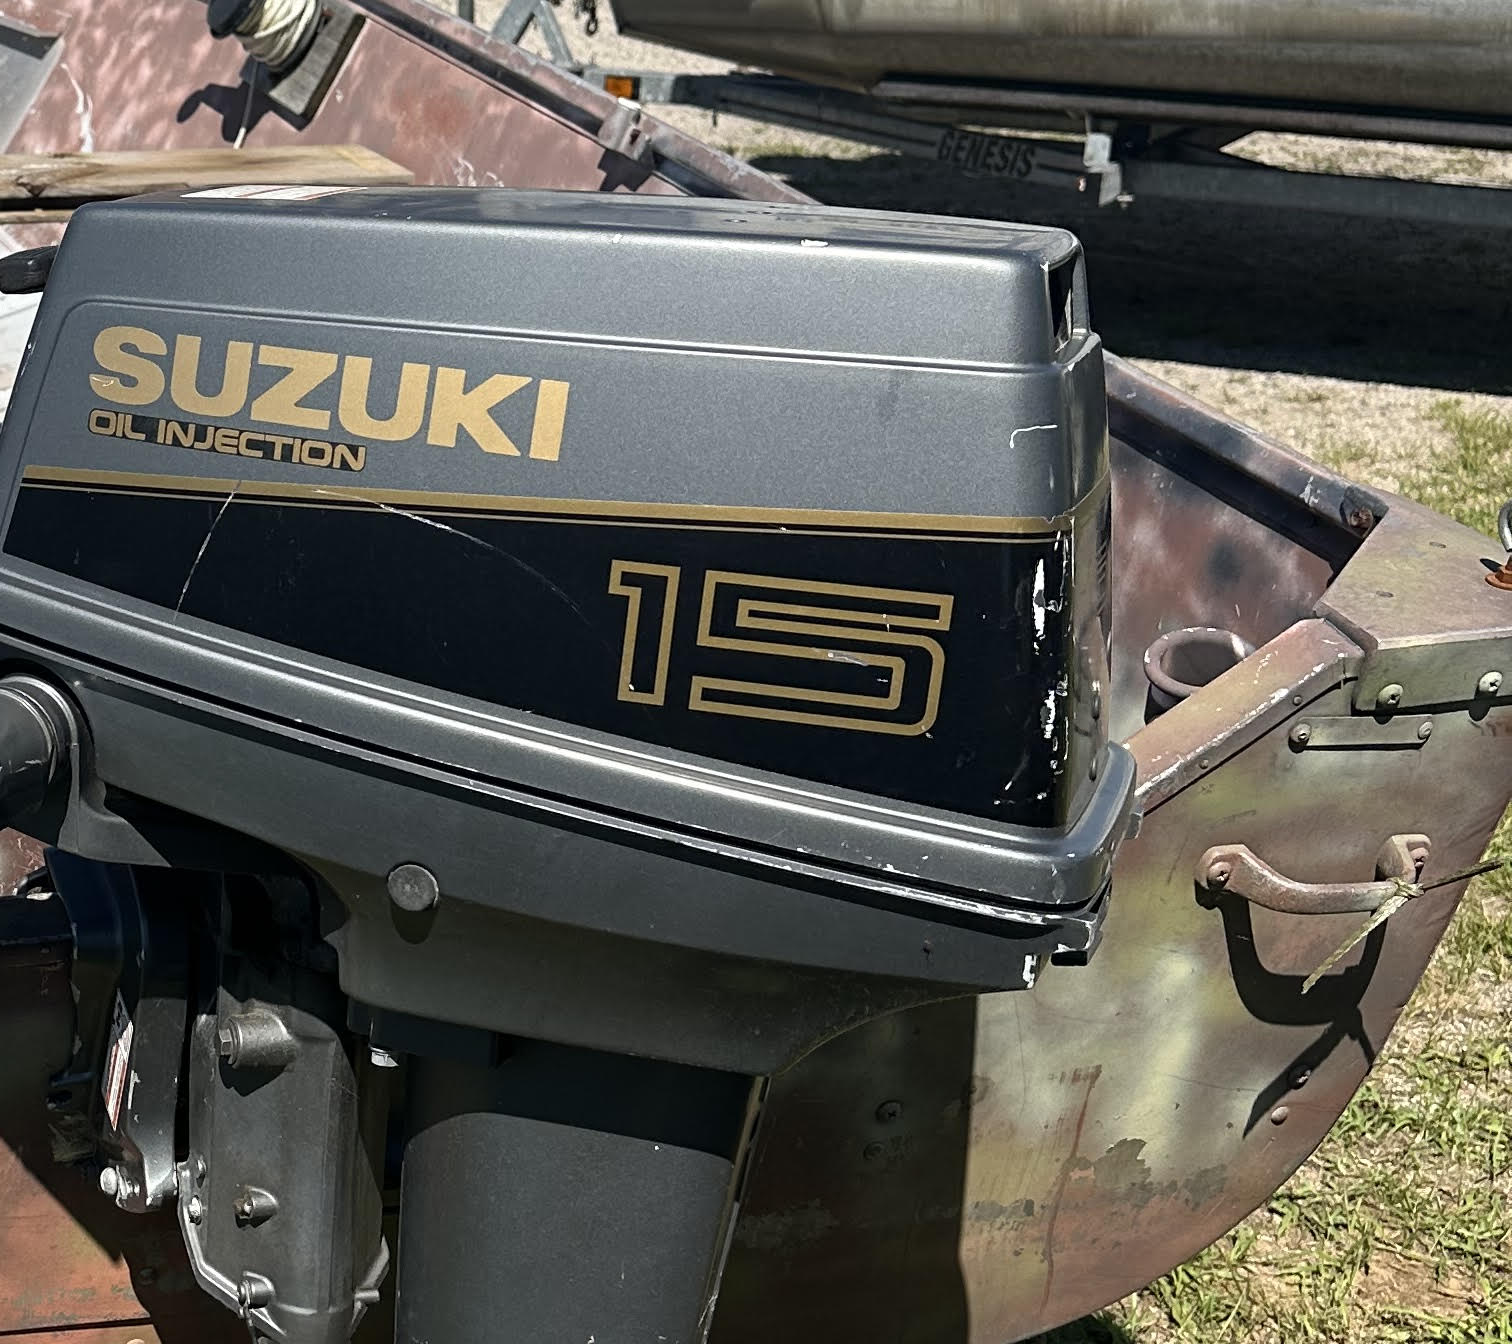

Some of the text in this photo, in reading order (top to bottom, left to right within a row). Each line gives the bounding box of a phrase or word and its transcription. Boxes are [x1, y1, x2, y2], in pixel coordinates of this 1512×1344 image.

[937, 130, 1035, 177] GENESIS
[88, 325, 570, 462] SUZUKI
[88, 409, 368, 470] OIL INJECTION
[608, 558, 955, 737] 15
